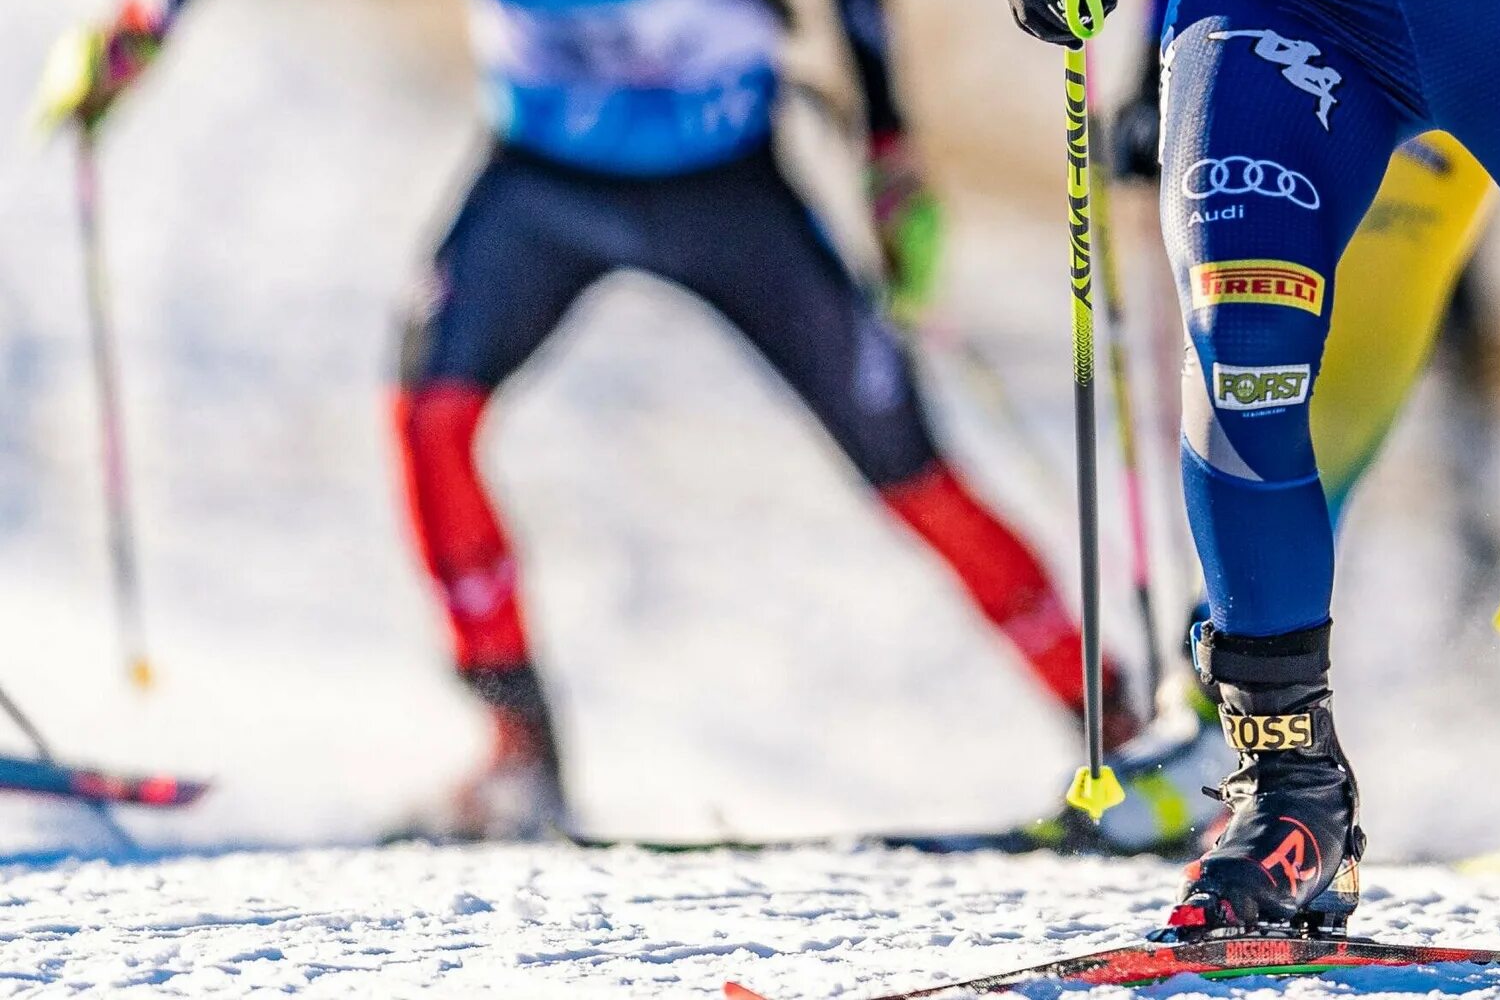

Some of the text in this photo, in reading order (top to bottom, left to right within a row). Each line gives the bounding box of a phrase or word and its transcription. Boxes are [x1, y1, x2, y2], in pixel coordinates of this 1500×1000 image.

[1187, 204, 1245, 227] Audi
[1201, 267, 1318, 304] PIRELLI
[1218, 371, 1309, 405] FORST
[1225, 715, 1312, 748] ROSS
